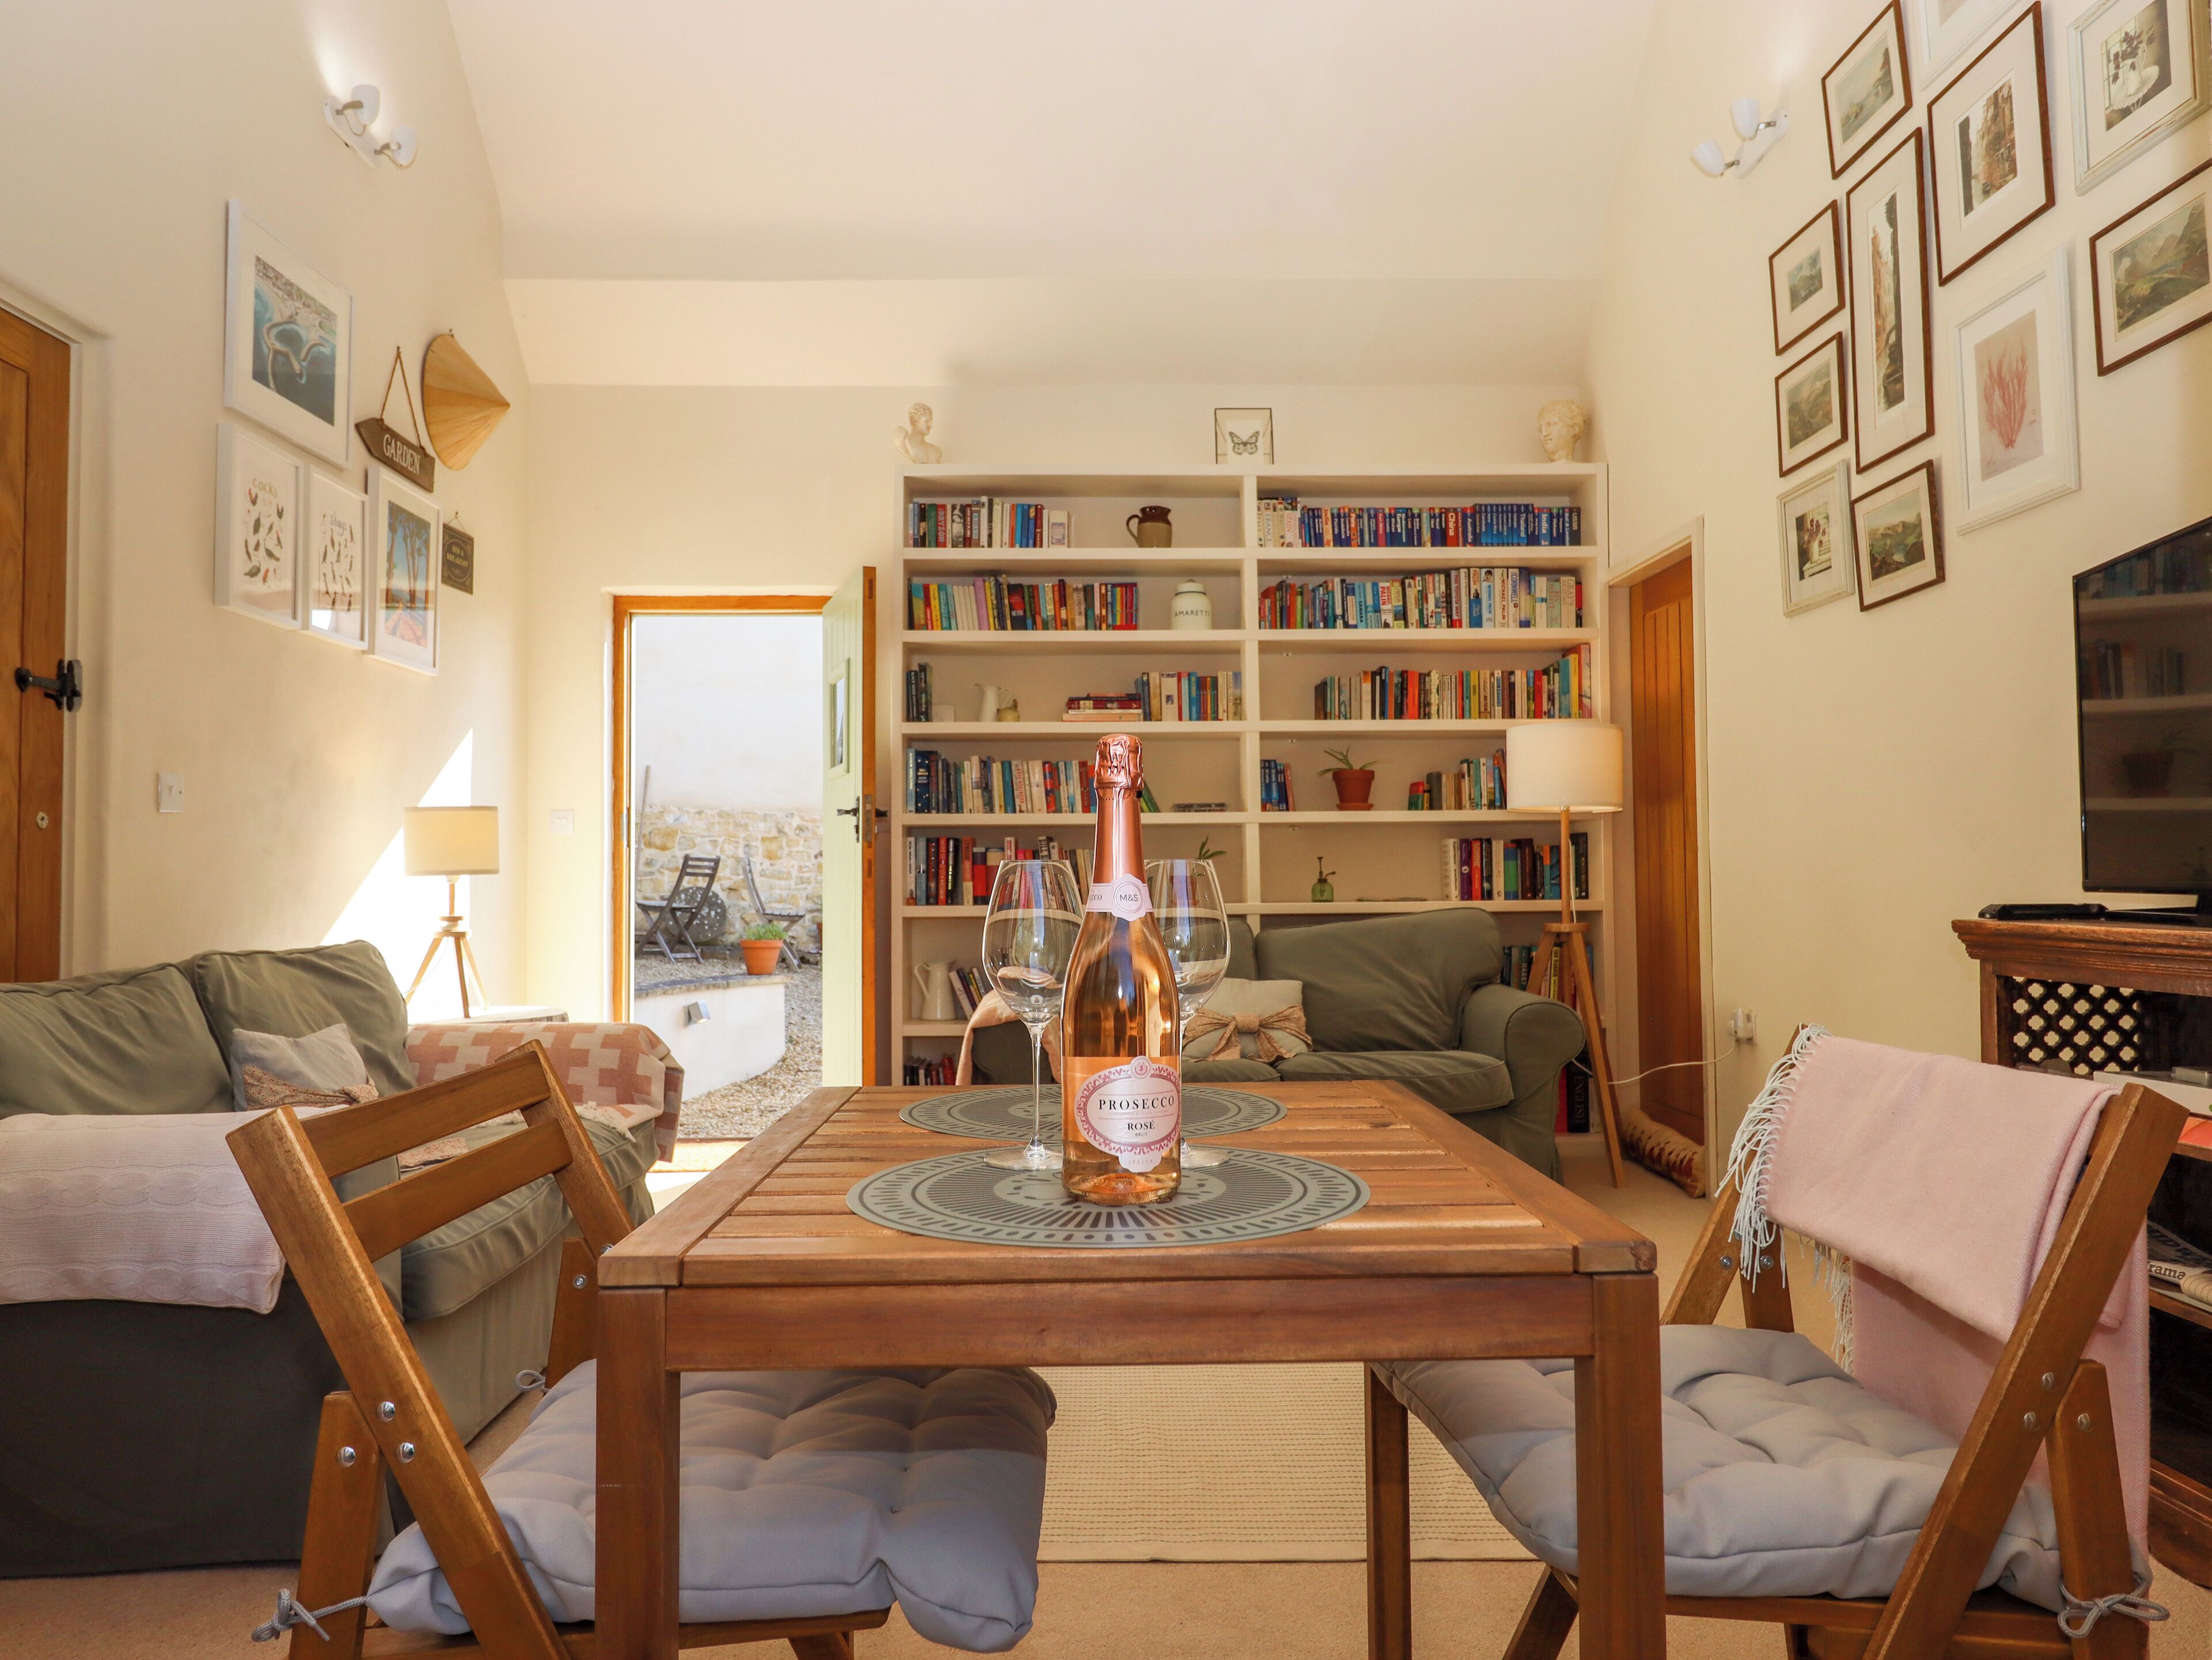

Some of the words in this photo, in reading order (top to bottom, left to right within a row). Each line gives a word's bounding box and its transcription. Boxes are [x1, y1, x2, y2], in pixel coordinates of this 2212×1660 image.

[383, 434, 421, 475] GARDEN
[1510, 574, 1518, 604] CORNWELL
[1120, 894, 1139, 902] M&S
[1098, 1095, 1175, 1110] PROSECCO
[1574, 1075, 1585, 1124] ENGLISH
[1127, 1119, 1156, 1131] ROSÉ
